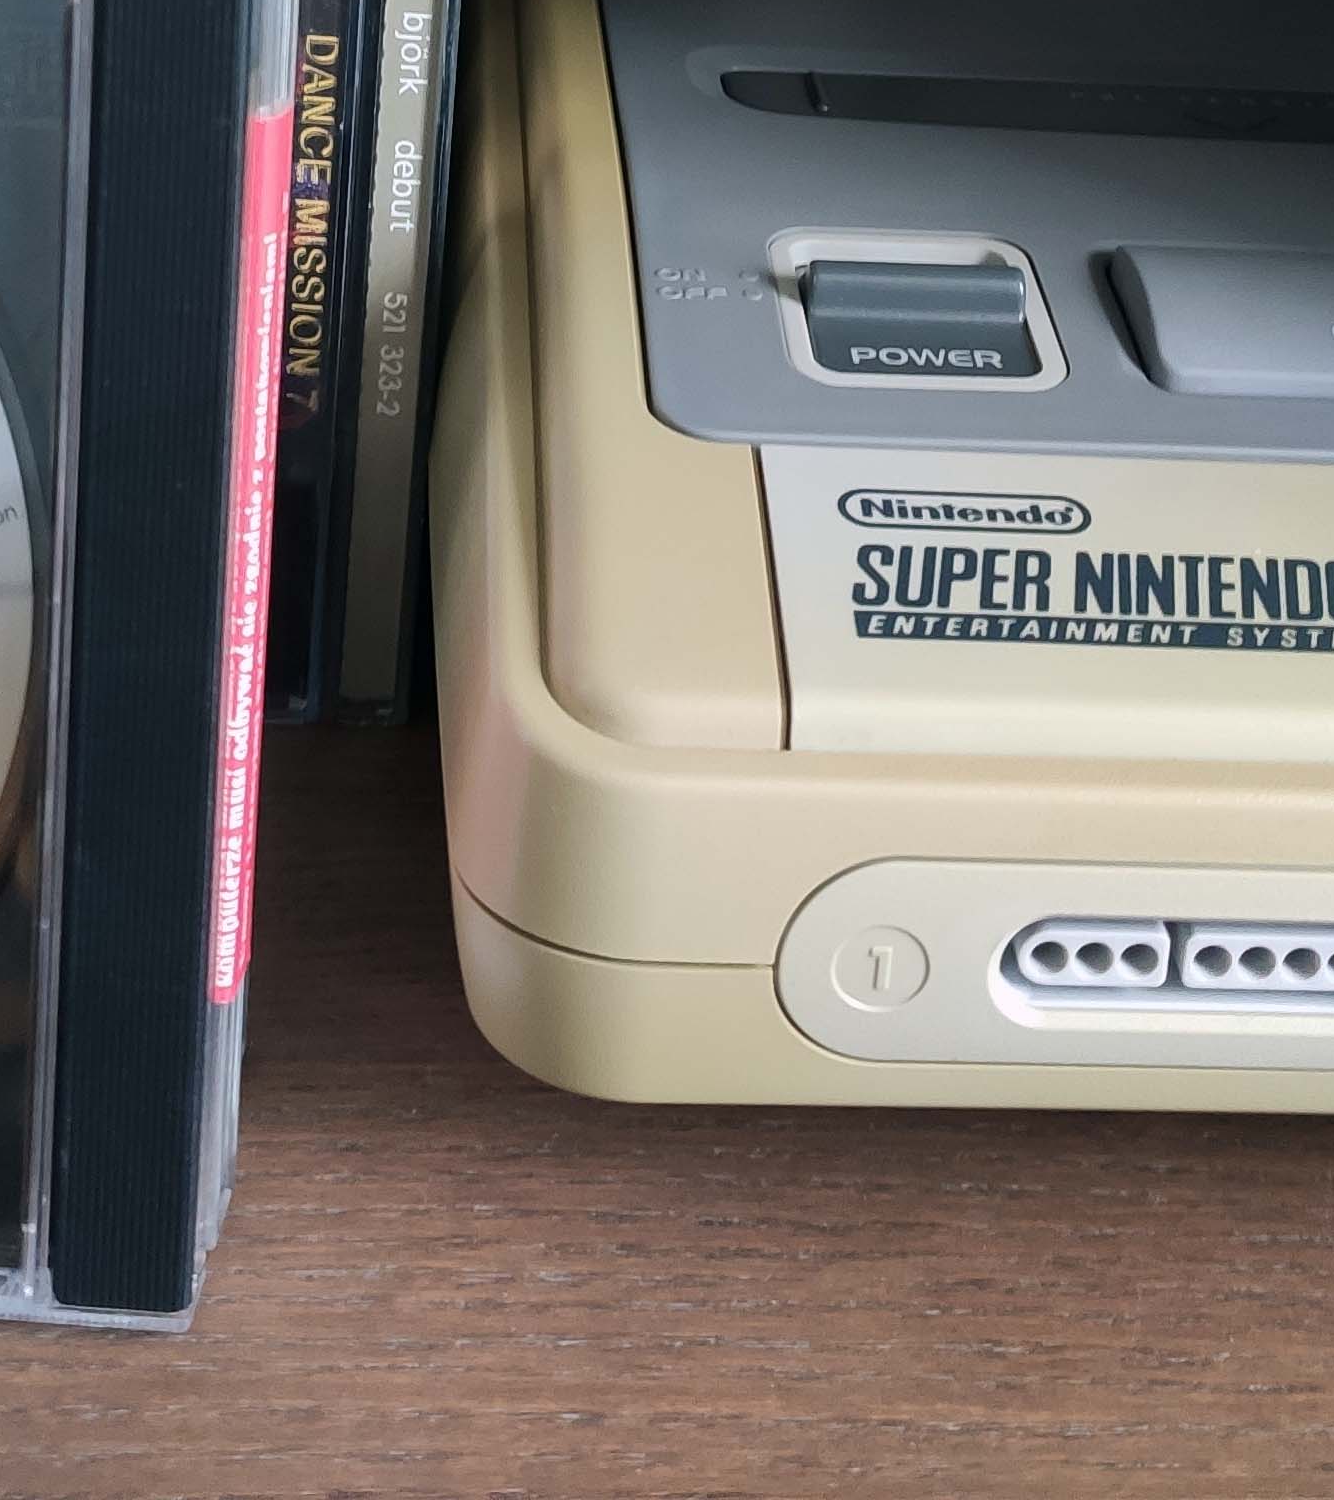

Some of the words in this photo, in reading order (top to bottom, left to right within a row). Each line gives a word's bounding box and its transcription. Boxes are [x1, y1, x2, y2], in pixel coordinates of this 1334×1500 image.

[397, 12, 433, 95] björk
[296, 34, 340, 186] DANCE
[390, 139, 423, 233] debut
[286, 198, 331, 376] MISSION
[382, 292, 407, 333] 521
[376, 344, 405, 417] 323-2
[848, 344, 1005, 372] POWER
[860, 498, 1076, 527] Nintendo
[852, 545, 1052, 612] SUPER
[868, 616, 1198, 646] ENTERTAINMENT
[222, 767, 248, 831] musi
